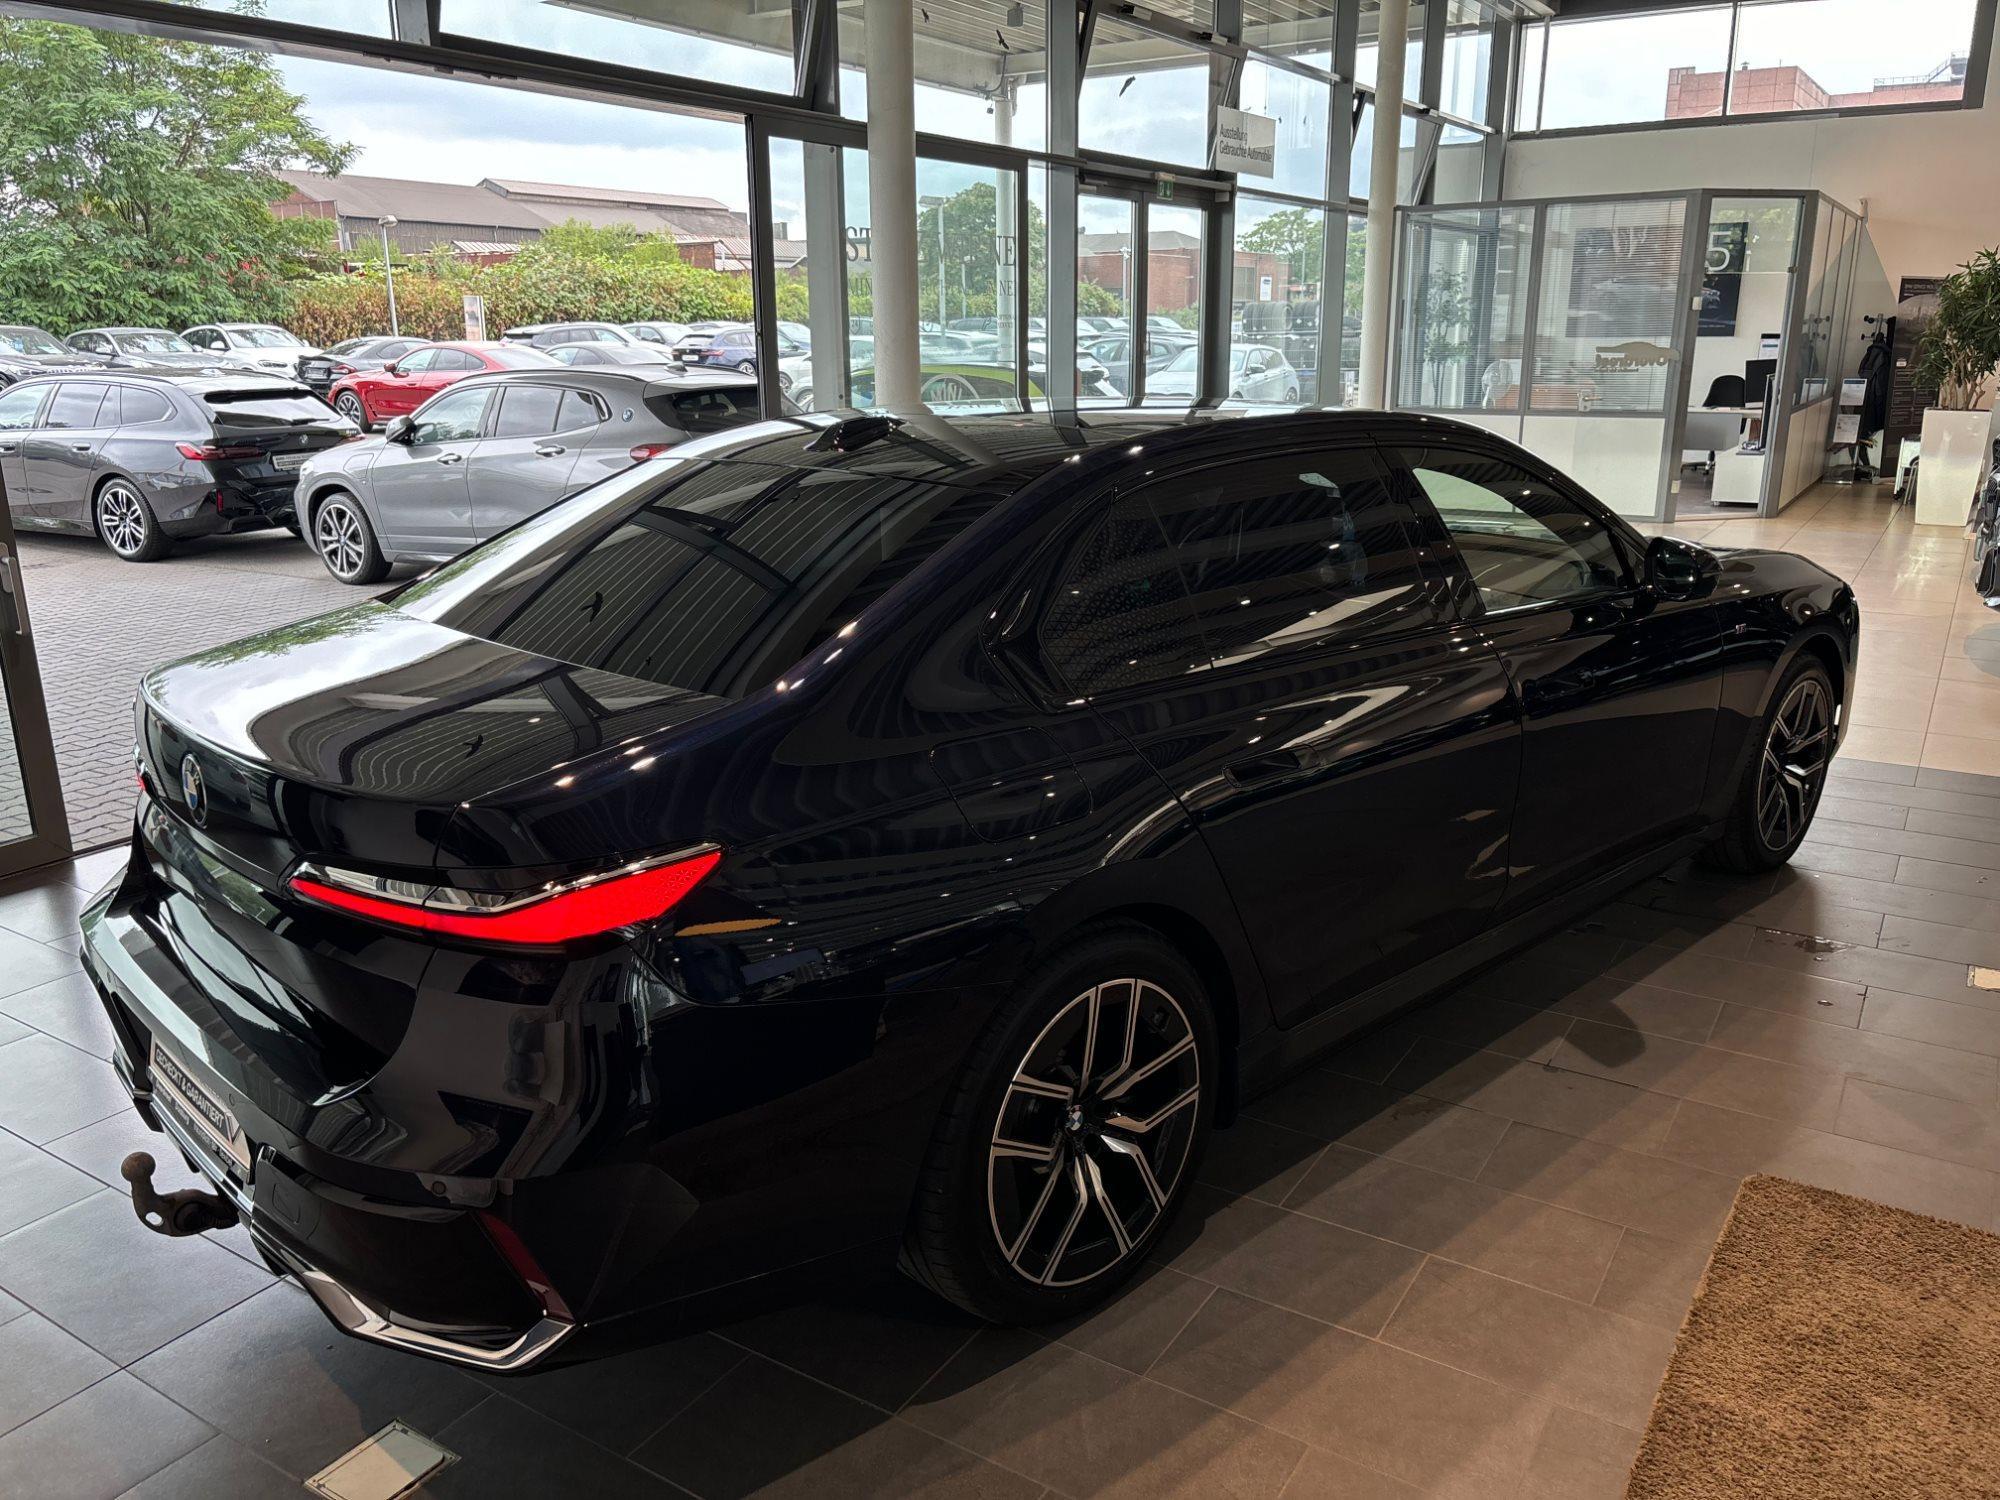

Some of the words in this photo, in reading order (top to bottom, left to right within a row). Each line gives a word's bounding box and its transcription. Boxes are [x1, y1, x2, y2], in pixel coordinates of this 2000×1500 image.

[1219, 123, 1248, 145] Ausstellung
[1219, 140, 1246, 158] Gebrauchte
[1247, 146, 1272, 163] Automobile
[186, 1082, 225, 1128] GARANTIERT
